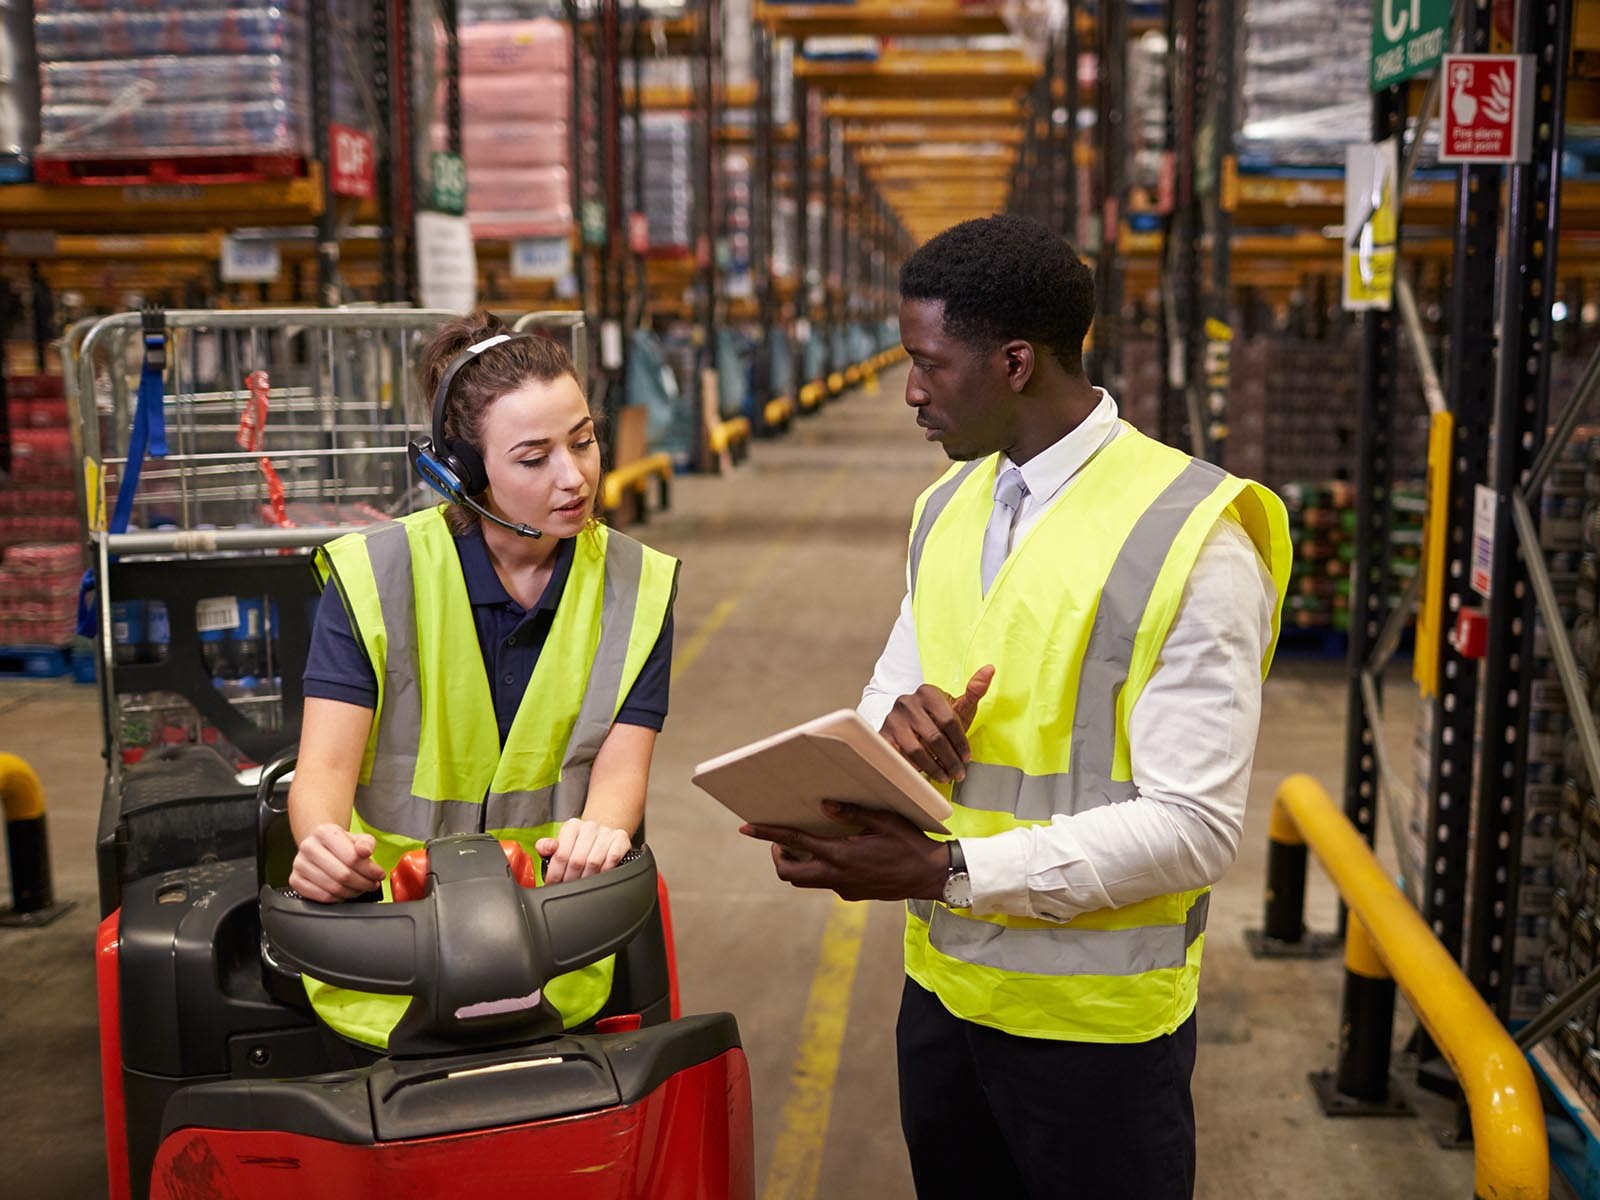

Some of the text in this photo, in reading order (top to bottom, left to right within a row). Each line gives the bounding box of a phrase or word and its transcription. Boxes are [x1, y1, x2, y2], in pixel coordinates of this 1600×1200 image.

[1453, 126, 1504, 140] Fire alarm
[1454, 140, 1501, 154] call point
